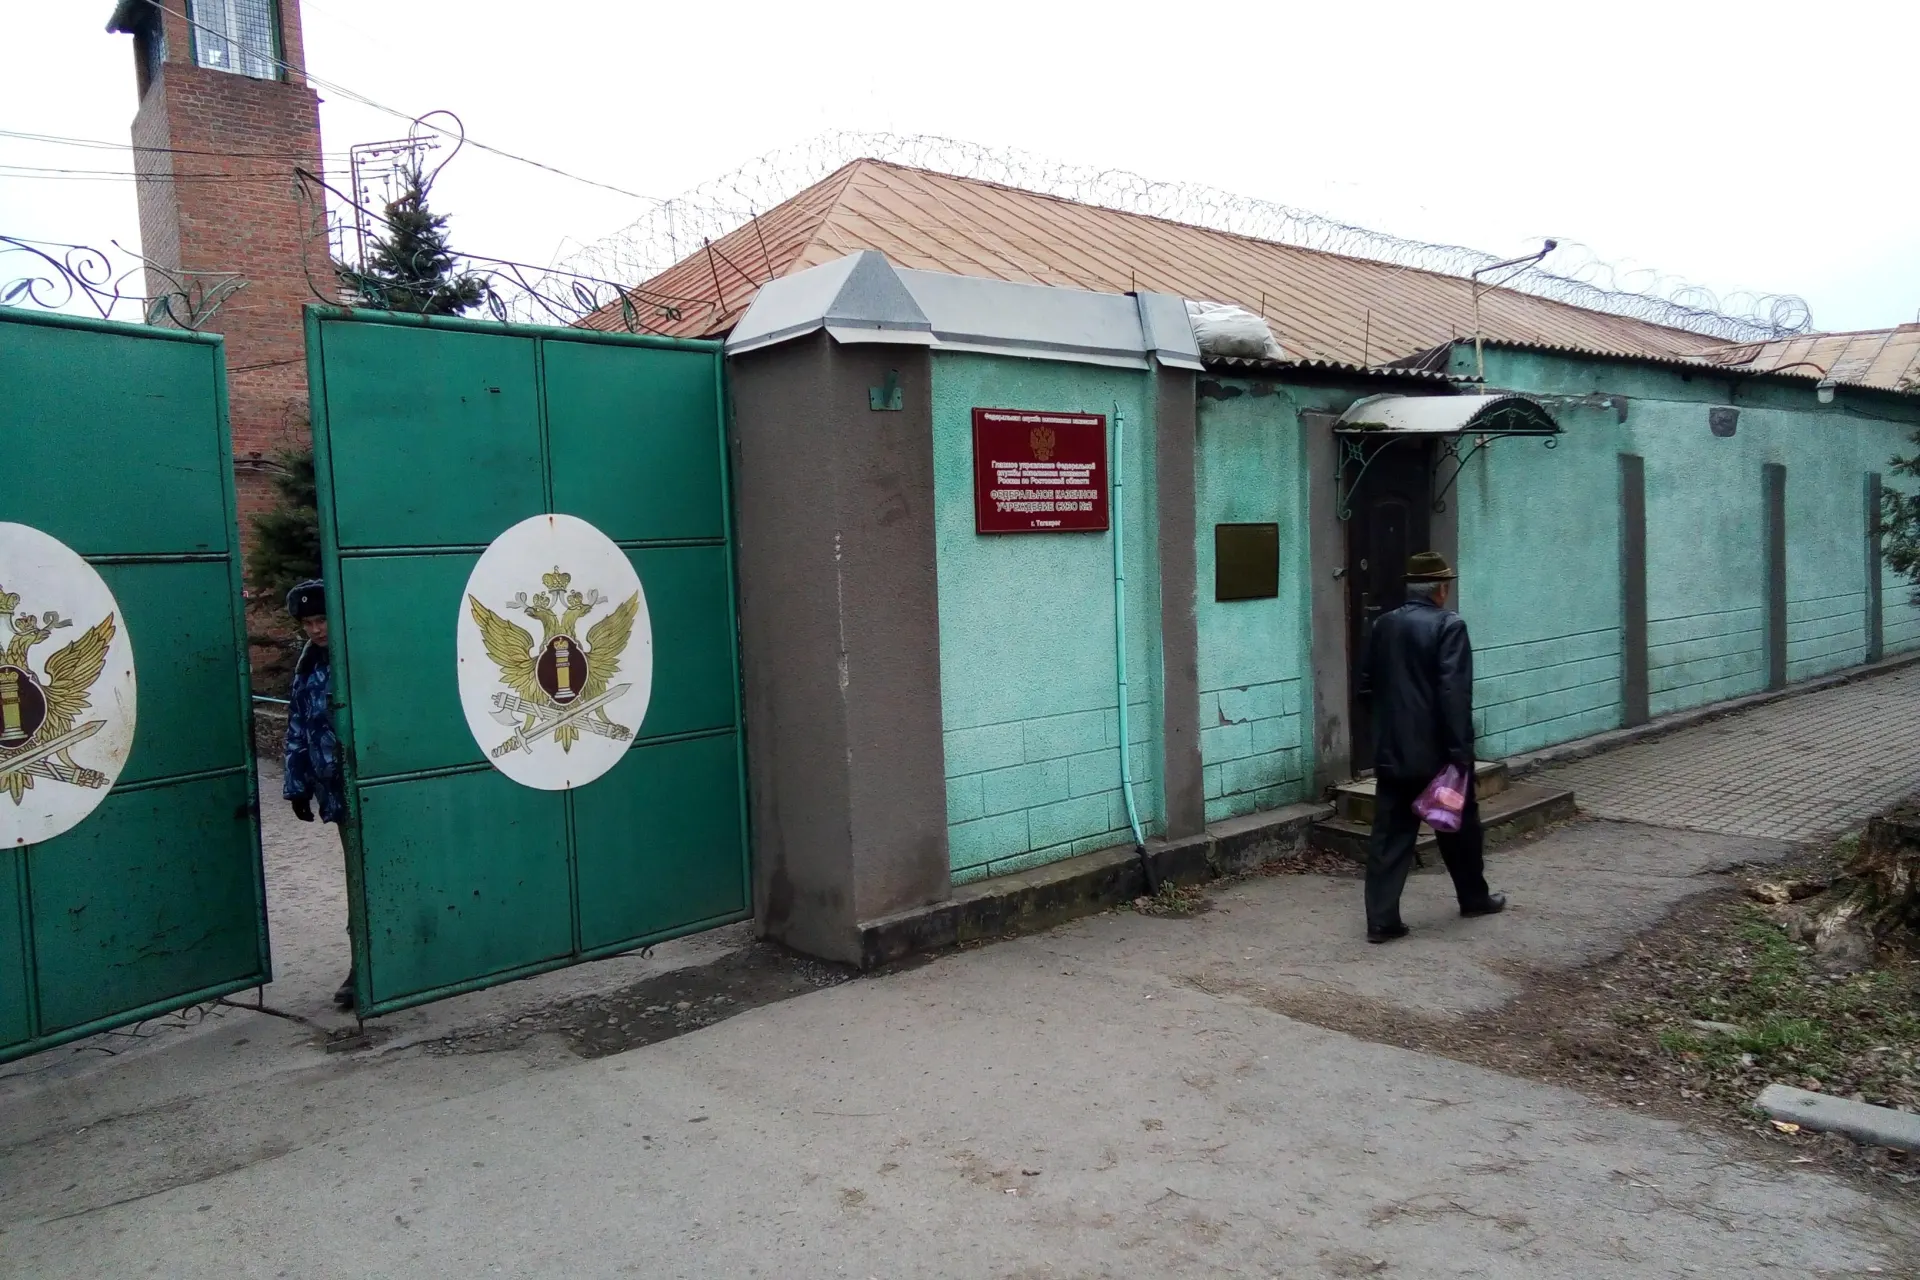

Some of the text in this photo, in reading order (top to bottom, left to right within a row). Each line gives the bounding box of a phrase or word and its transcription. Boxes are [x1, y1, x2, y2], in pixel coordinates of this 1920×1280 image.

[990, 489, 1098, 501] ФЕДЕРАЛЬНОЕ КАЗЕННОЕ
[996, 501, 1054, 513] УЧРЕЖДЕНИЕ
[1055, 501, 1078, 512] СИЗО
